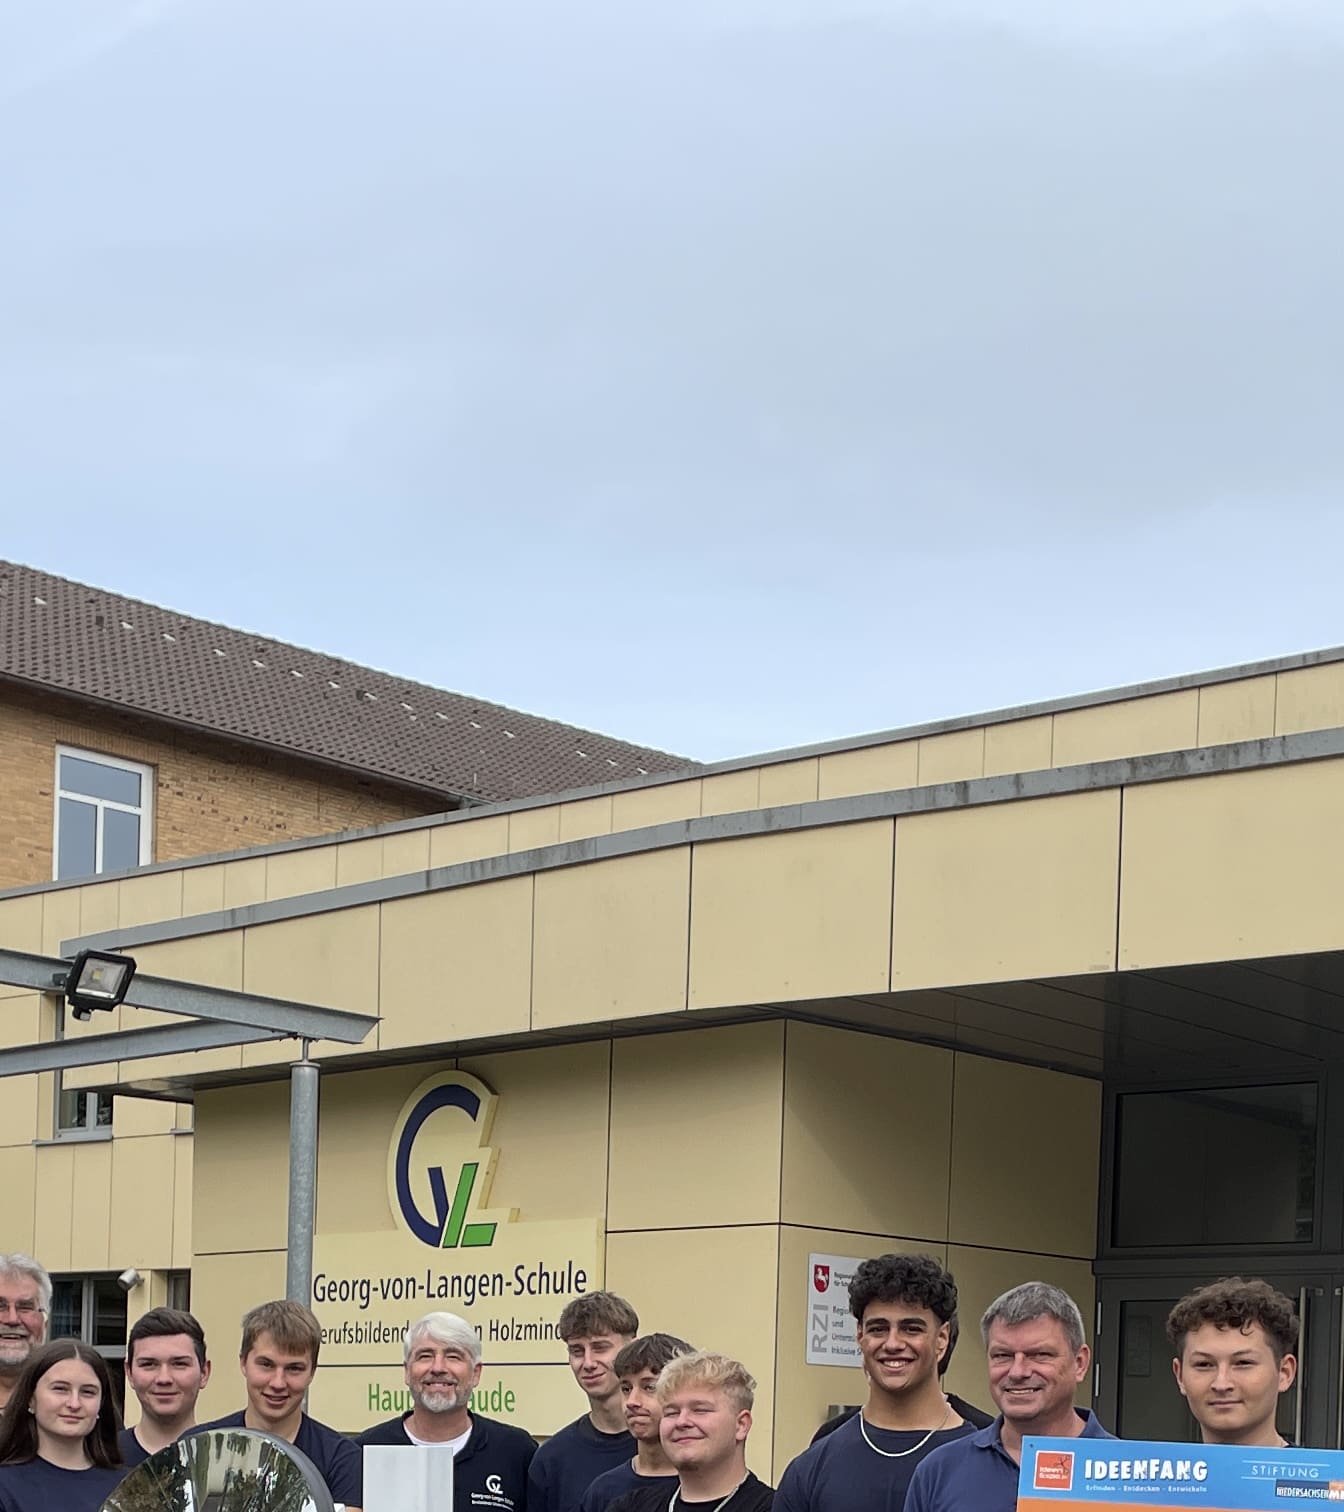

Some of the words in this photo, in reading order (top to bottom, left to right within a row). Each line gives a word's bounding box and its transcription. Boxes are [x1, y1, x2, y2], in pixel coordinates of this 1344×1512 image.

[313, 1260, 587, 1309] Georg-von-Langen-Schule
[320, 1320, 408, 1345] erufsbildend
[1084, 1459, 1208, 1482] IDEENFANG
[1251, 1465, 1320, 1478] STIFTUNG
